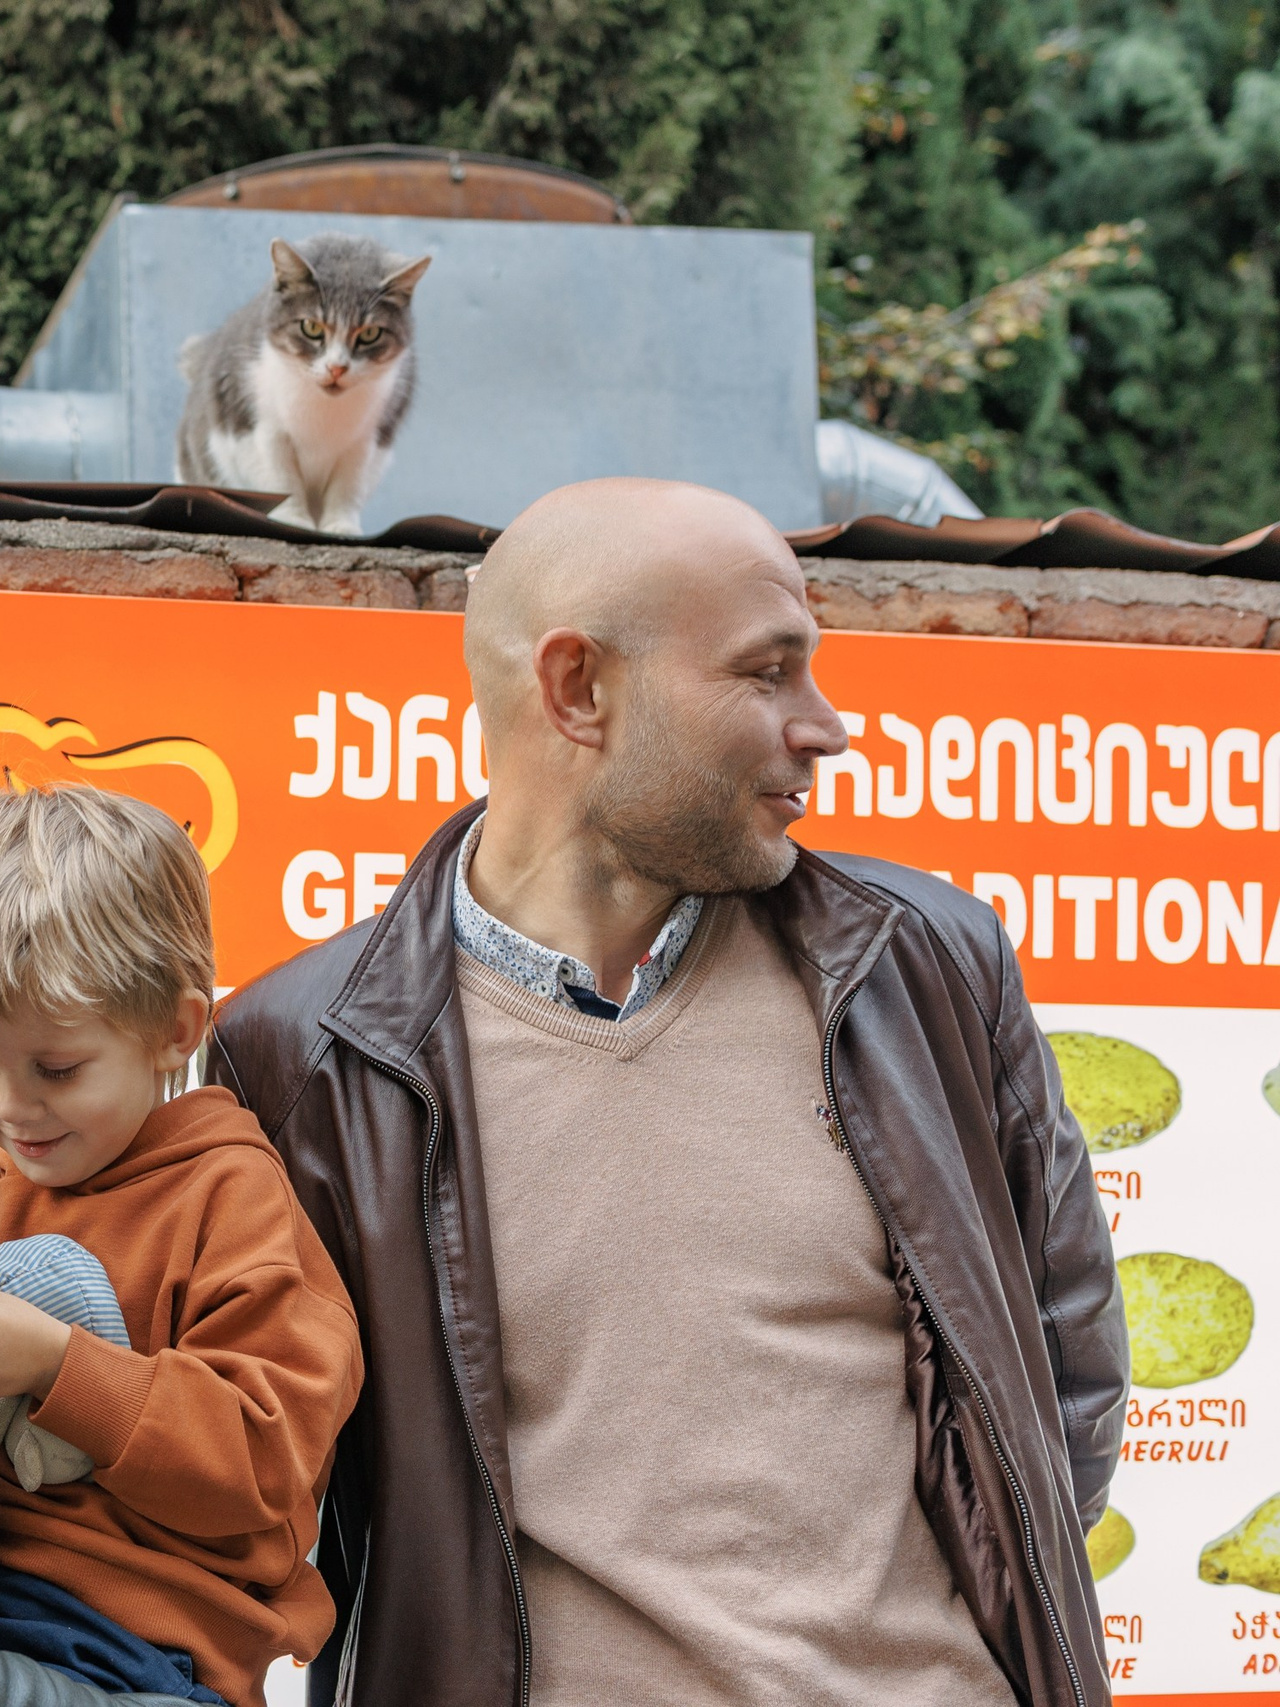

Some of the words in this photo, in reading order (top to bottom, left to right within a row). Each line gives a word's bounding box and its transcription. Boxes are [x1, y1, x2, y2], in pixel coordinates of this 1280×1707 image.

[798, 710, 1280, 832] რადიციულ
[282, 849, 406, 940] GE
[930, 870, 1280, 967] DITION
[1094, 1171, 1141, 1199] ლი
[1126, 1399, 1246, 1427] გრული
[1104, 1615, 1143, 1644] ლი
[1242, 1653, 1280, 1675] AD
